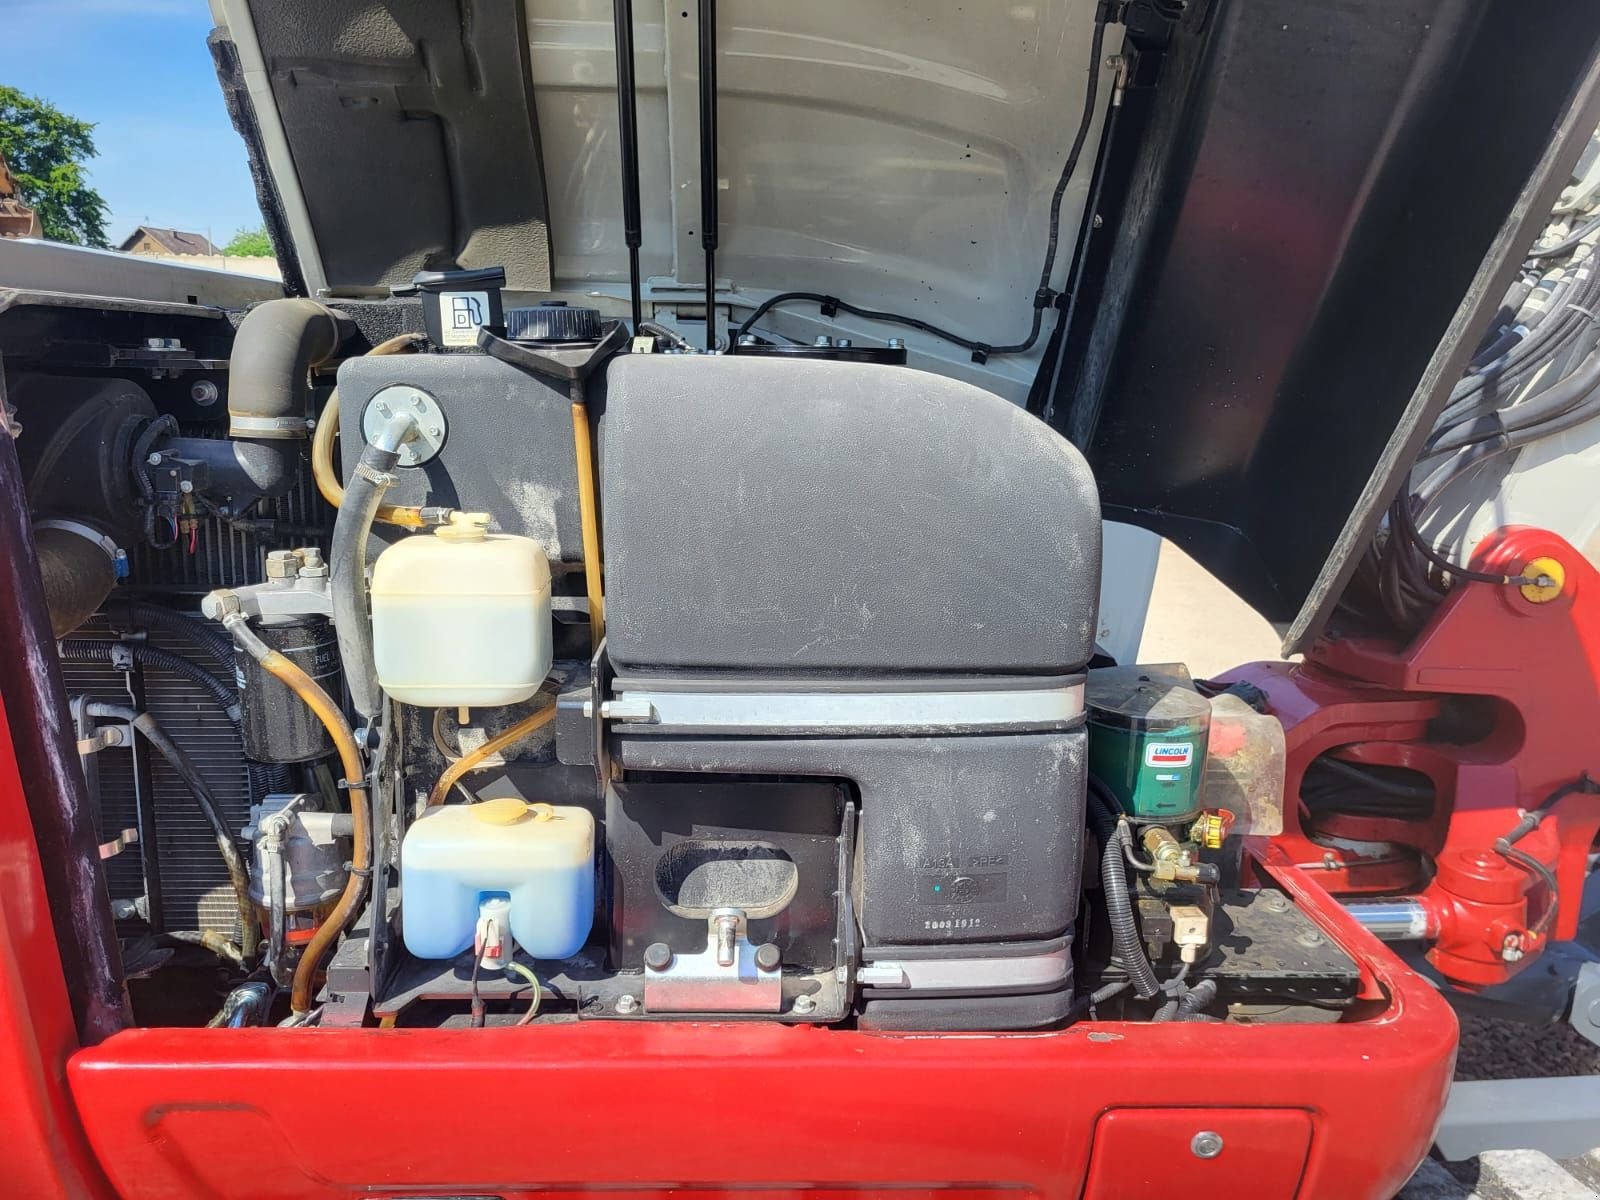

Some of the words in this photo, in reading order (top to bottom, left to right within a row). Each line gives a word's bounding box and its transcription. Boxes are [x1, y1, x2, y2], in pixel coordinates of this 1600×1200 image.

[458, 315, 466, 324] D
[315, 652, 330, 664] FUEL
[1154, 747, 1189, 755] LINCOLN
